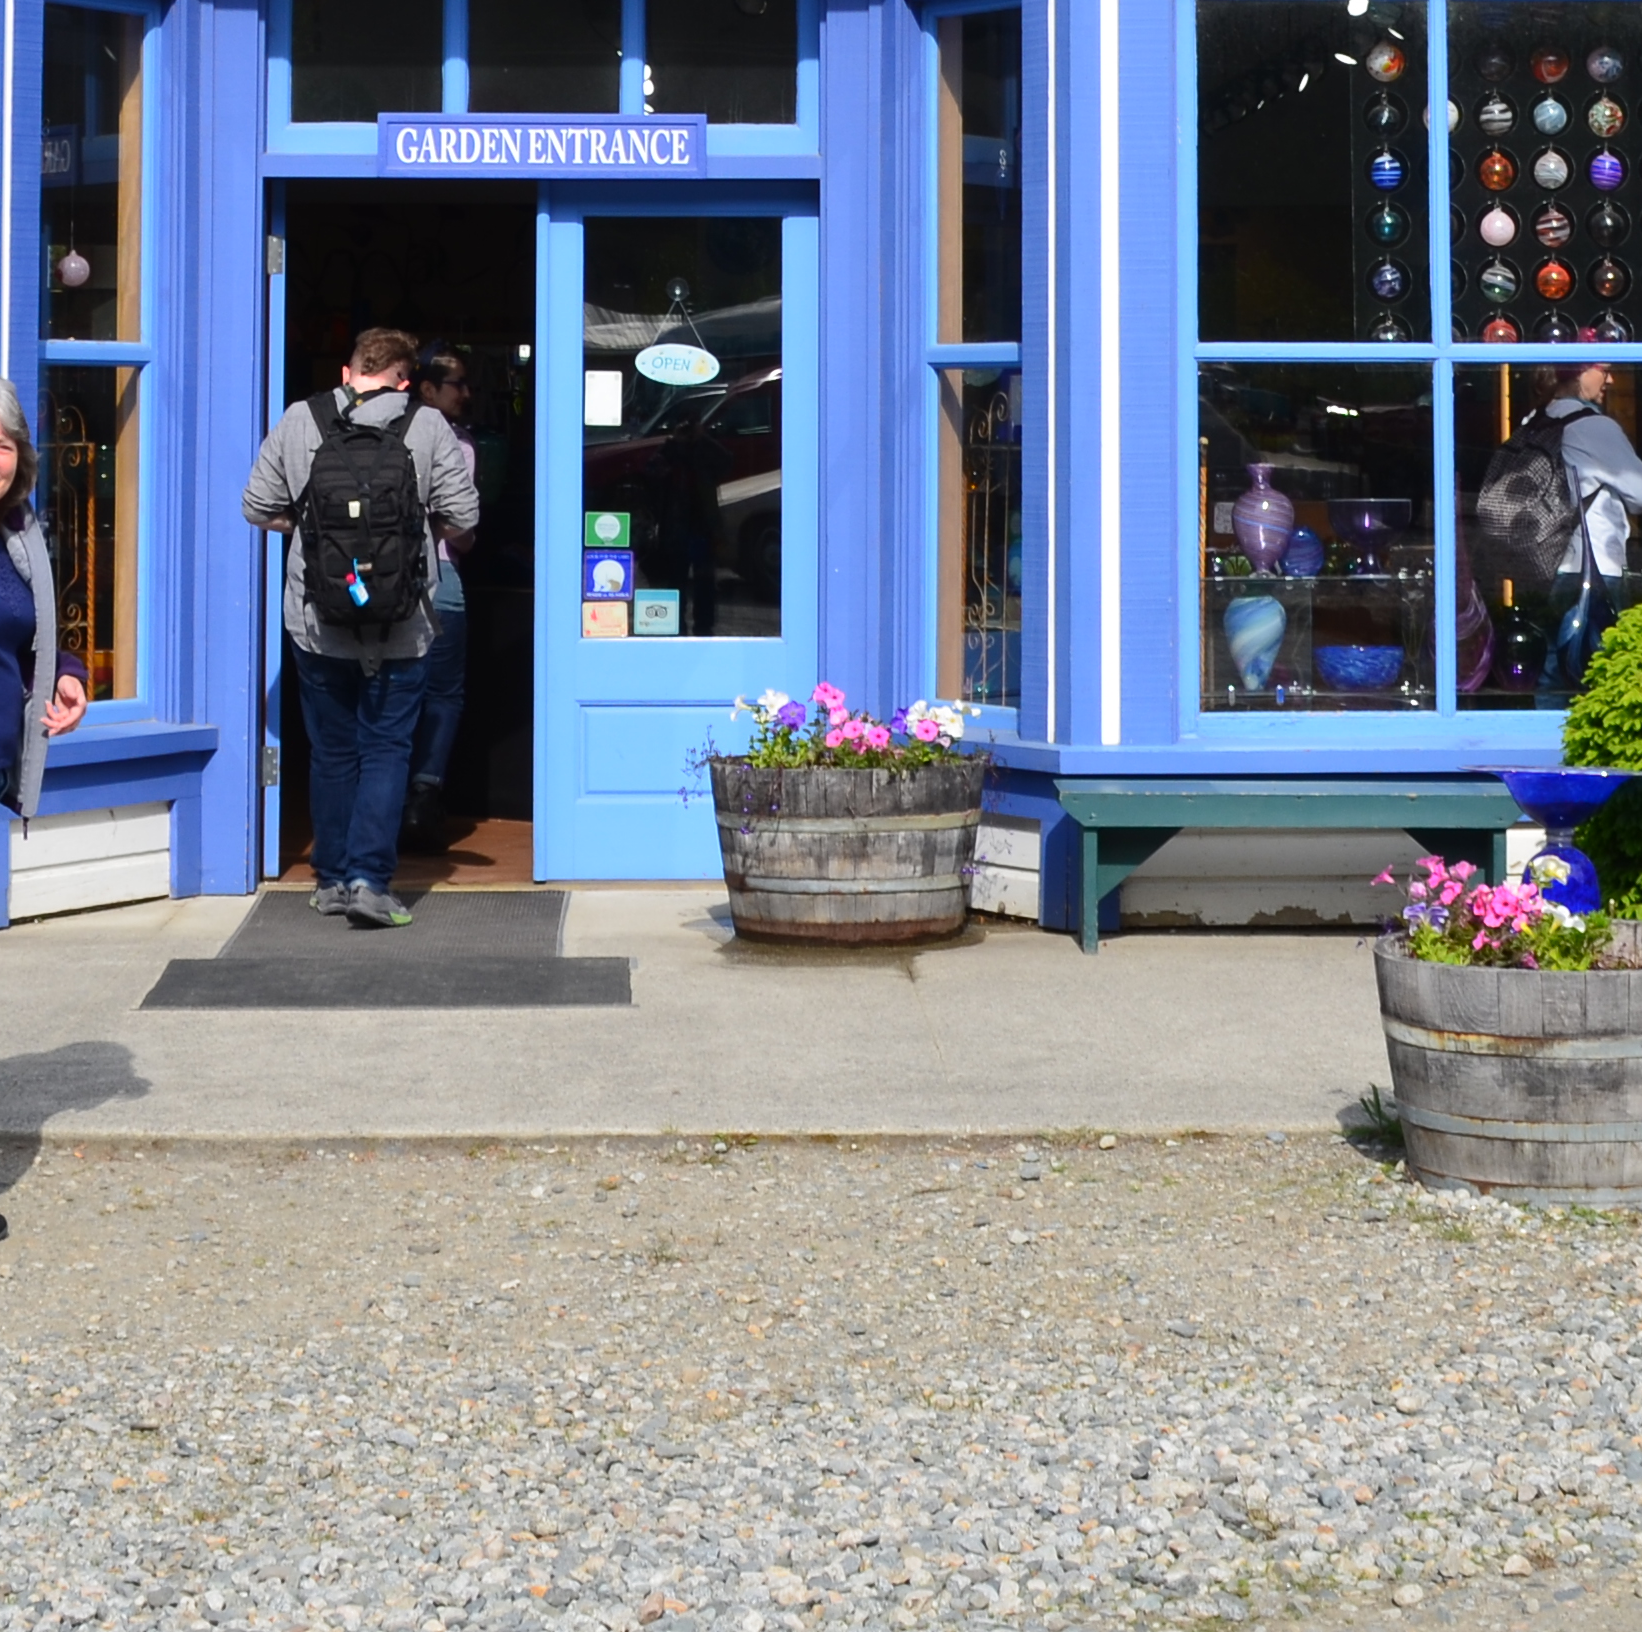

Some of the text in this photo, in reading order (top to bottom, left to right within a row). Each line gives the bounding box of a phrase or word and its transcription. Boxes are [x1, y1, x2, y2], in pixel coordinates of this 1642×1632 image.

[396, 127, 689, 165] GARDEN ENTRANCE
[651, 356, 691, 371] OPEN
